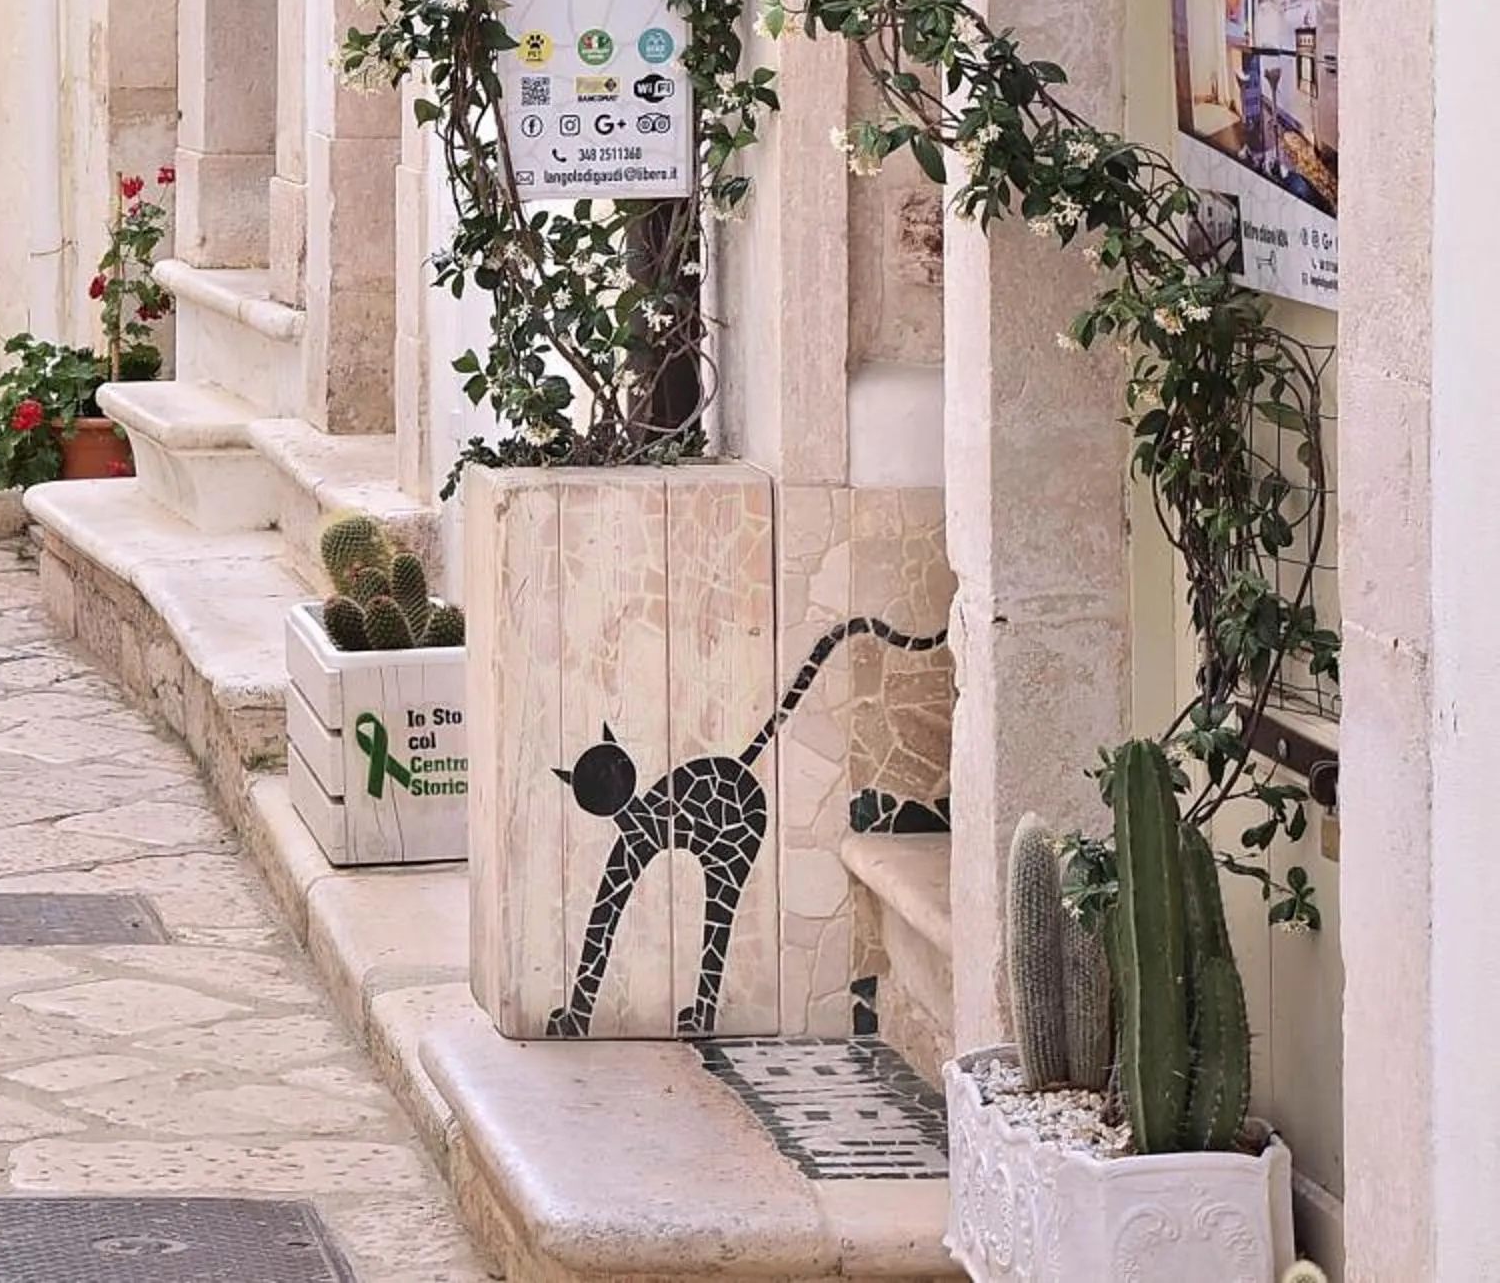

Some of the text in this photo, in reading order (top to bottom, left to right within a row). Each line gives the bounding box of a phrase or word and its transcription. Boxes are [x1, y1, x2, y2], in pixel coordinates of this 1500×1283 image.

[407, 708, 463, 728] Io Sto
[408, 730, 437, 750] col
[411, 778, 469, 797] Storic
